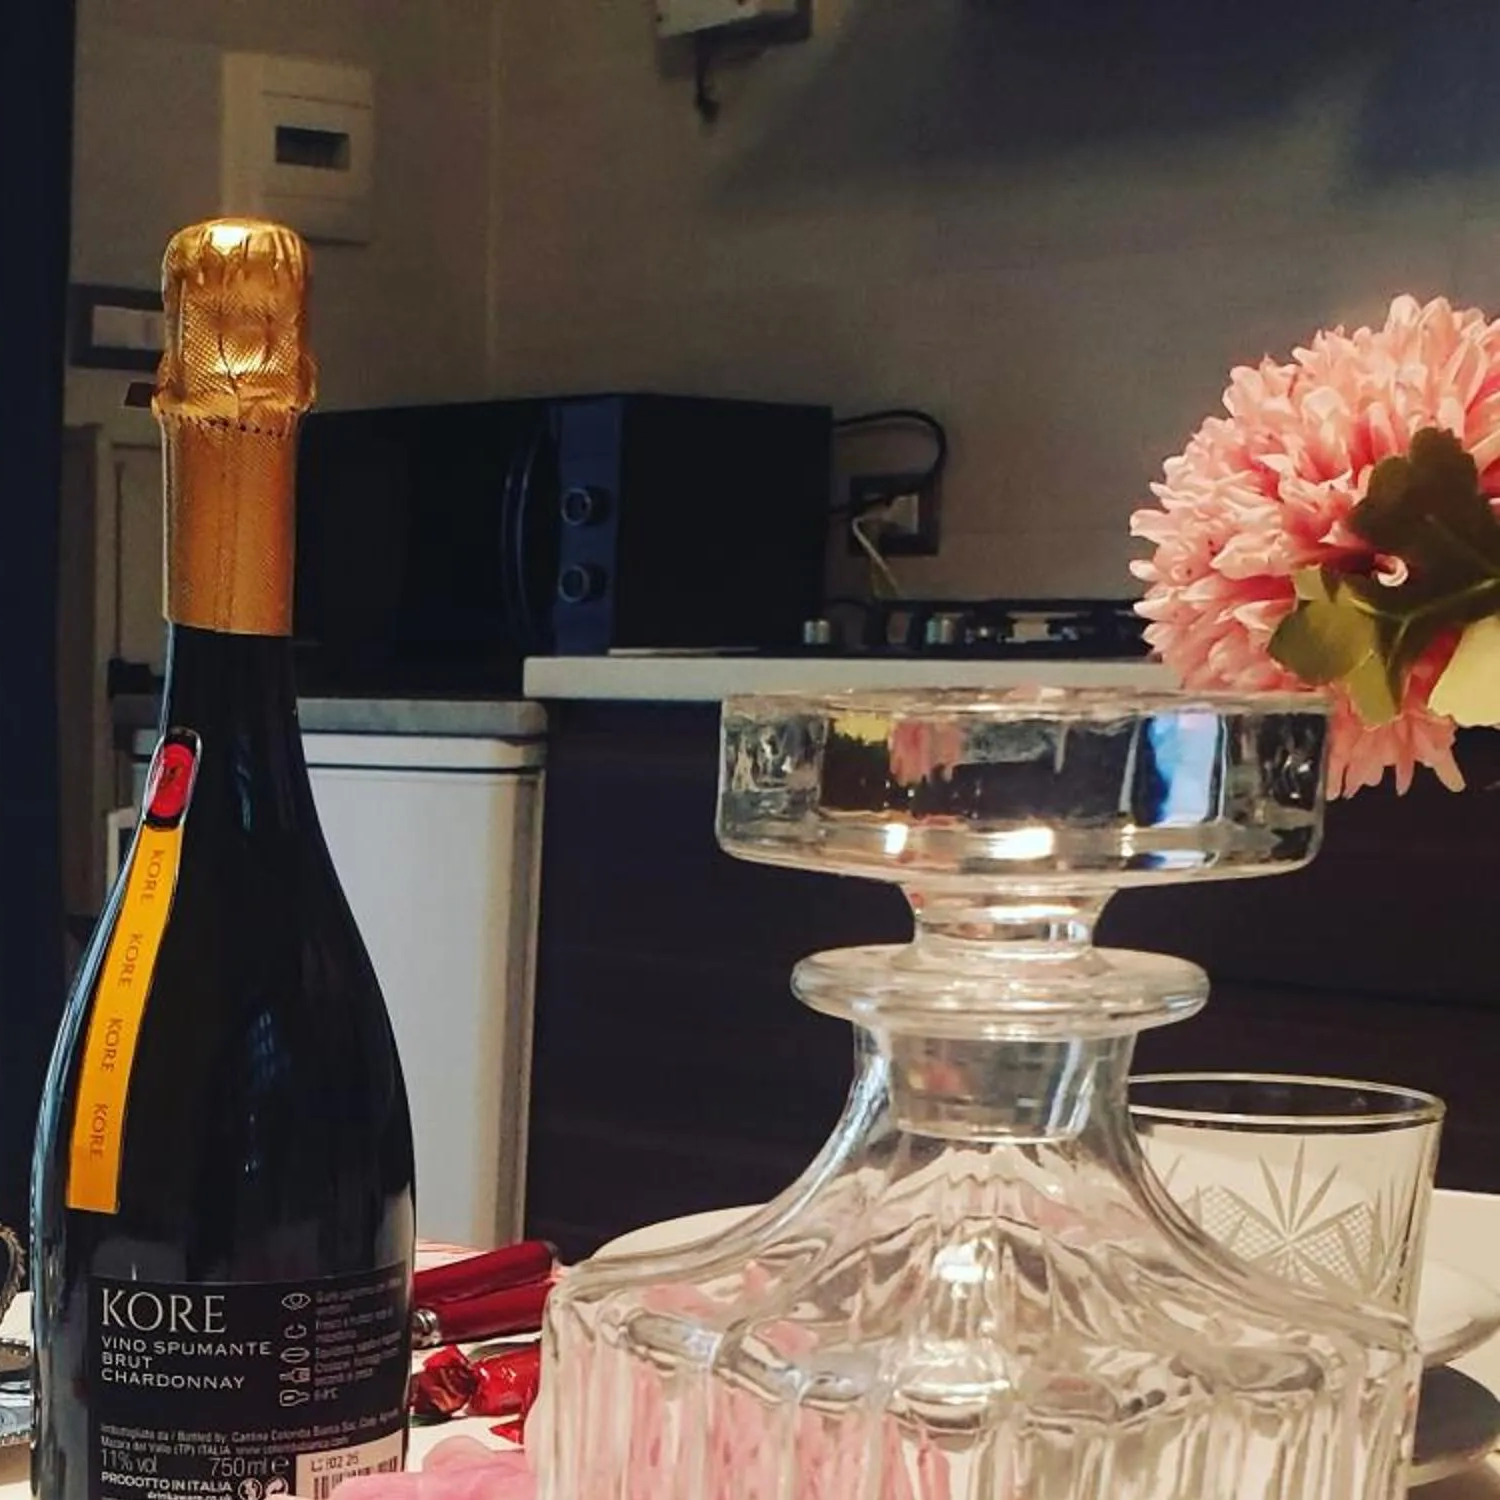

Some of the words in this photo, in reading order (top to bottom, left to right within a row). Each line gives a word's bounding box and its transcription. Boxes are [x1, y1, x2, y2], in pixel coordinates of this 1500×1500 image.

[141, 849, 164, 902] KORE
[119, 933, 143, 988] KORE
[102, 1017, 123, 1073] KORE
[90, 1103, 109, 1161] KORE
[101, 1287, 227, 1333] KORE
[101, 1335, 147, 1353] VINO
[153, 1340, 272, 1357] SPUMANTE
[101, 1352, 153, 1369] BRUT
[101, 1369, 246, 1390] CHARDONNAY
[101, 1449, 133, 1471] 11%
[136, 1454, 158, 1474] vol
[210, 1457, 245, 1477] 750
[101, 1471, 171, 1490] PRODOTTO
[172, 1479, 186, 1492] IN
[188, 1480, 233, 1493] ITALIA
